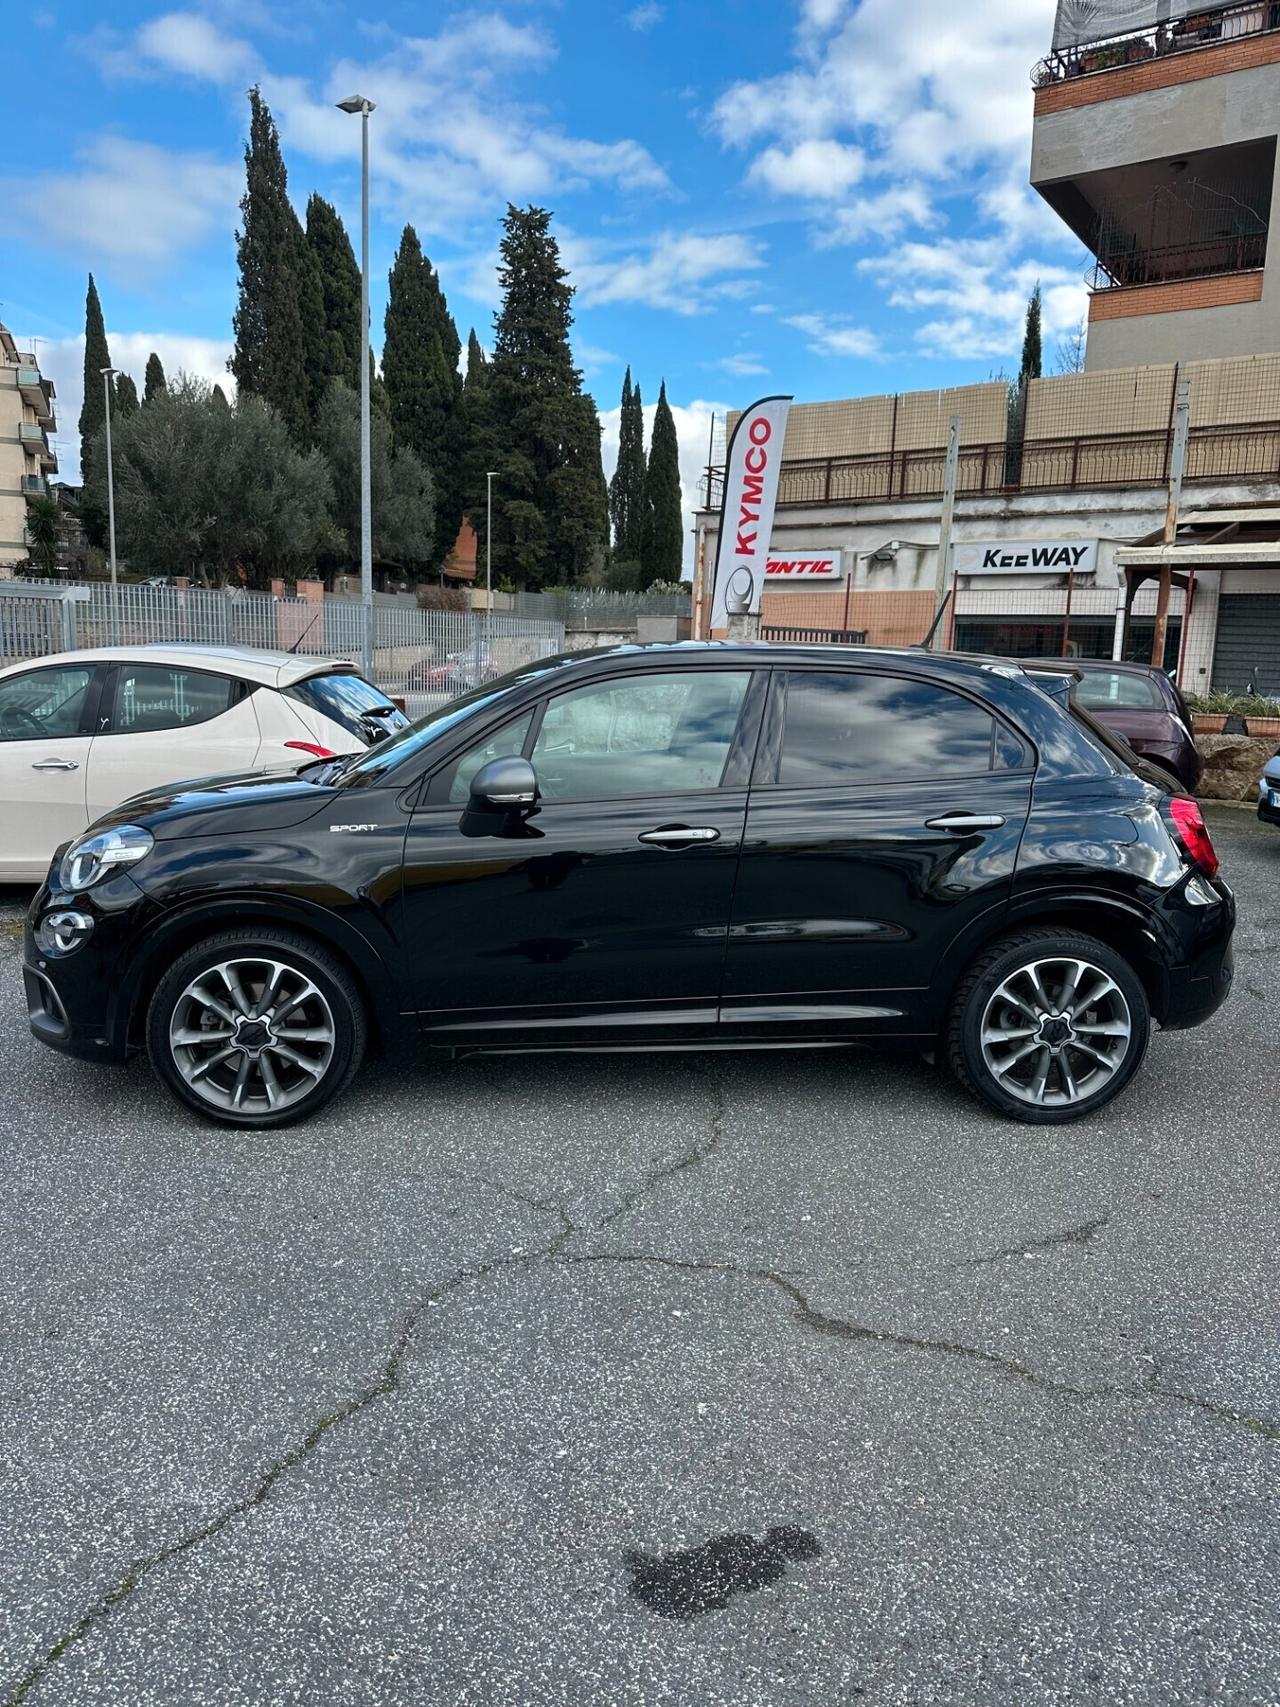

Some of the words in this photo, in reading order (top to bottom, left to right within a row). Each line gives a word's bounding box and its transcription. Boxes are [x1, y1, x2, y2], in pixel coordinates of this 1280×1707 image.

[735, 417, 772, 556] KYMCO
[765, 557, 833, 574] ANTIC
[330, 824, 378, 832] SPORT
